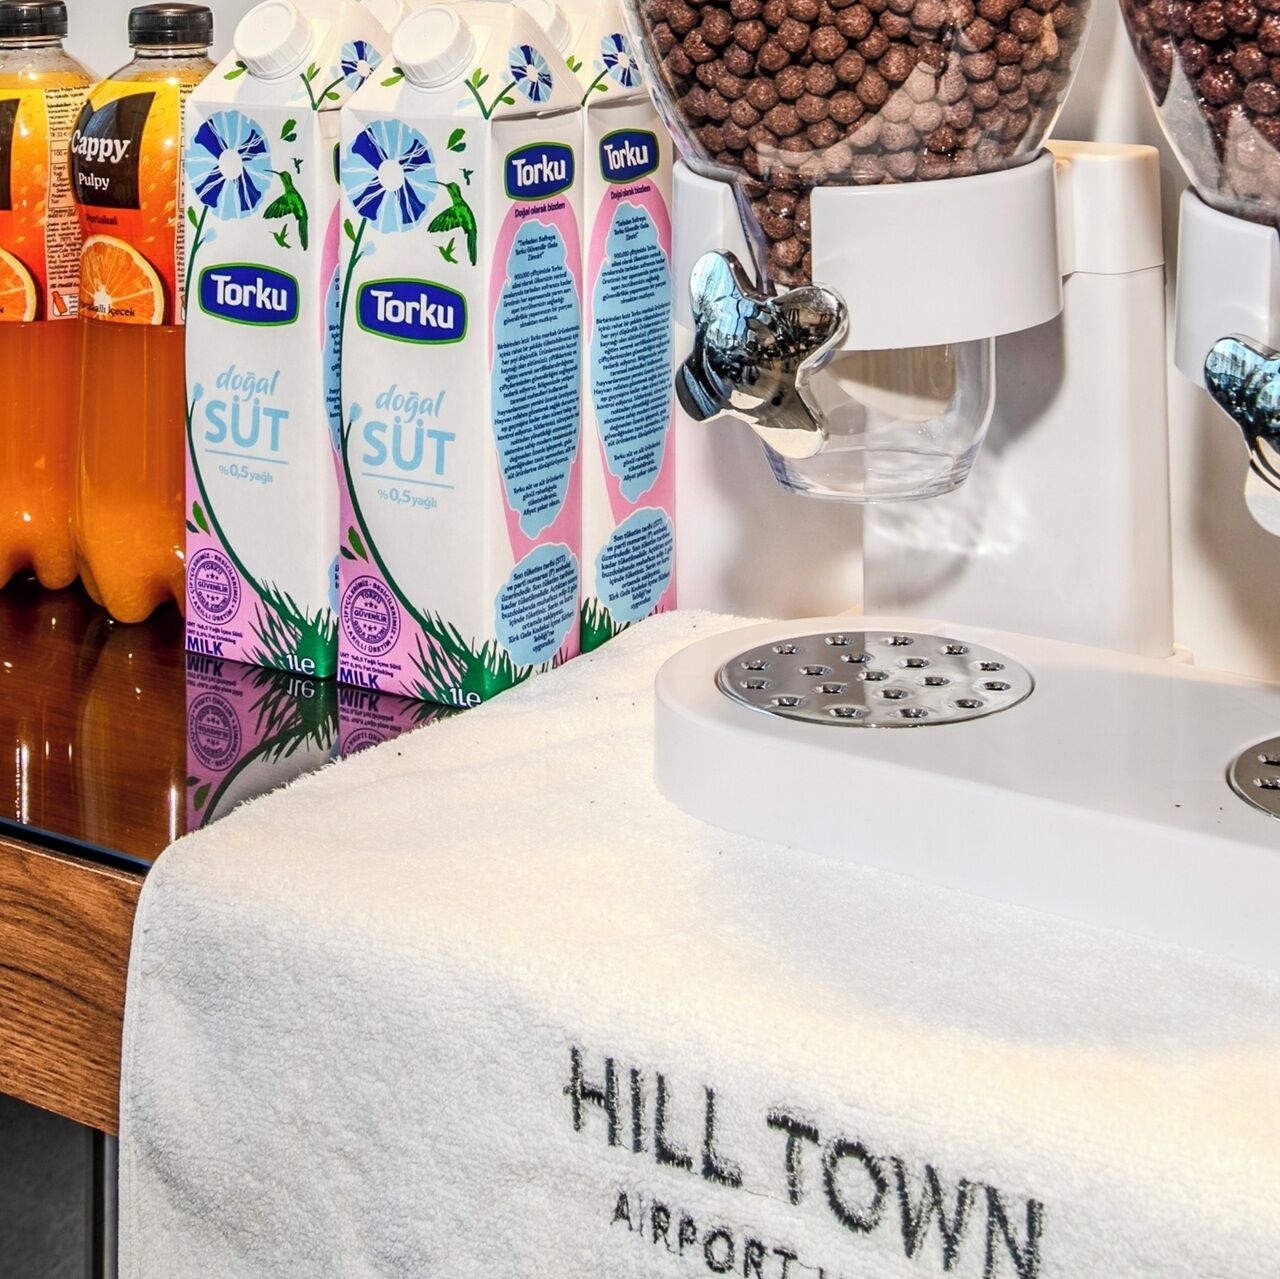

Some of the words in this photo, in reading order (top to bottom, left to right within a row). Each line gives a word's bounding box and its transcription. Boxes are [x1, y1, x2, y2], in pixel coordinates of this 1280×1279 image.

[71, 129, 130, 164] Cappy
[603, 140, 649, 170] Torku
[78, 173, 110, 191] Pulpy
[512, 152, 566, 186] Torku
[514, 208, 531, 219] Doğal
[531, 206, 547, 215] olarak
[548, 202, 565, 212] bizden
[210, 273, 287, 314] Torku
[370, 288, 454, 331] Torku
[216, 364, 281, 402] doğal
[375, 384, 445, 423] doğal
[204, 395, 289, 451] SÜT
[362, 416, 456, 475] SÜT
[249, 470, 273, 484] yağlı
[412, 495, 437, 510] yağlı
[203, 564, 223, 575] TORKU
[361, 592, 382, 604] TORKU
[187, 636, 223, 656] MILK
[340, 667, 379, 688] MILK
[563, 1045, 743, 1188] HILL
[766, 1105, 1045, 1279] TOWN
